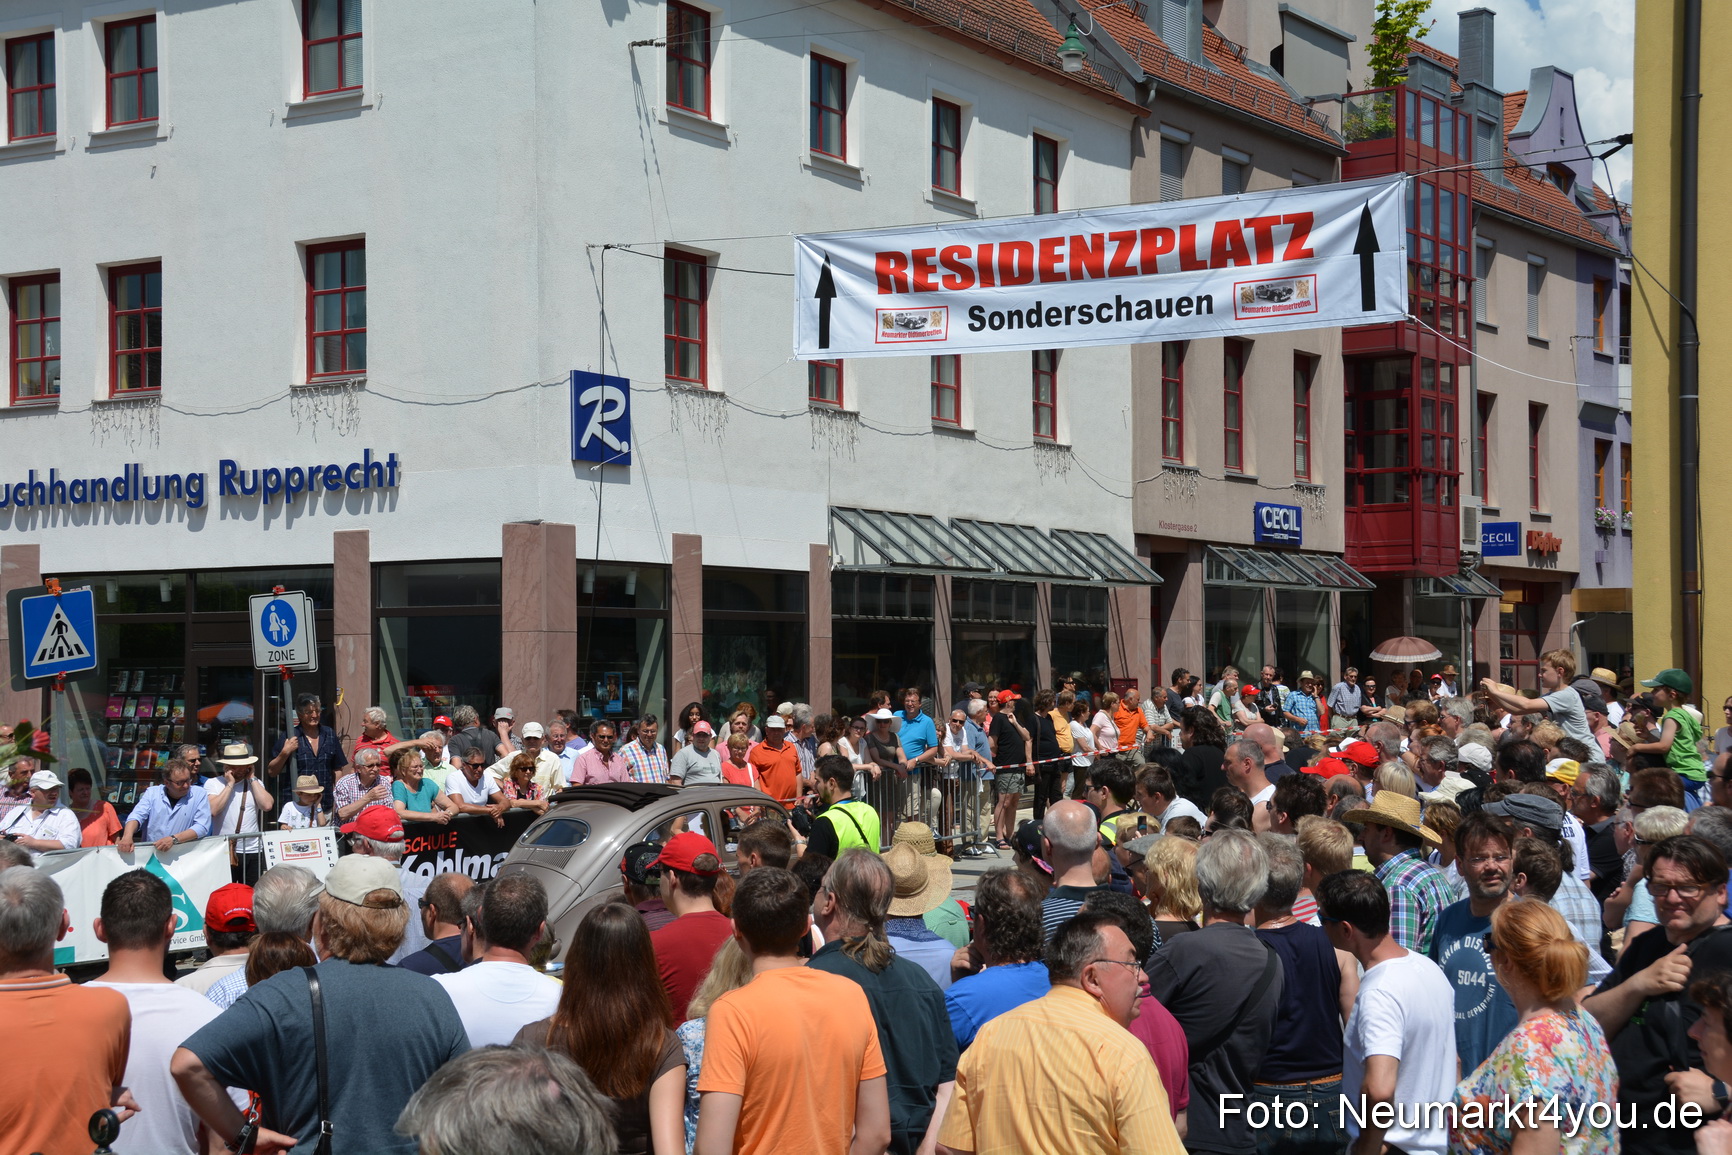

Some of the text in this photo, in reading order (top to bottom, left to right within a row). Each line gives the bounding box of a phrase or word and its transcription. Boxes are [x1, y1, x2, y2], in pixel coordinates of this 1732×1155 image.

[875, 211, 1315, 295] RESIDENZPLATZ
[967, 294, 1214, 333] Sonderschauen
[1241, 299, 1312, 314] Neumarkter Oldtimertreffen
[219, 448, 399, 505] Rupprecht
[1158, 519, 1198, 532] Klostergasse 2
[1262, 506, 1301, 531] CECIL
[1481, 533, 1515, 543] CECIL
[267, 649, 296, 662] ZONE
[402, 831, 458, 854] SCHULE
[1458, 969, 1486, 987] 5044
